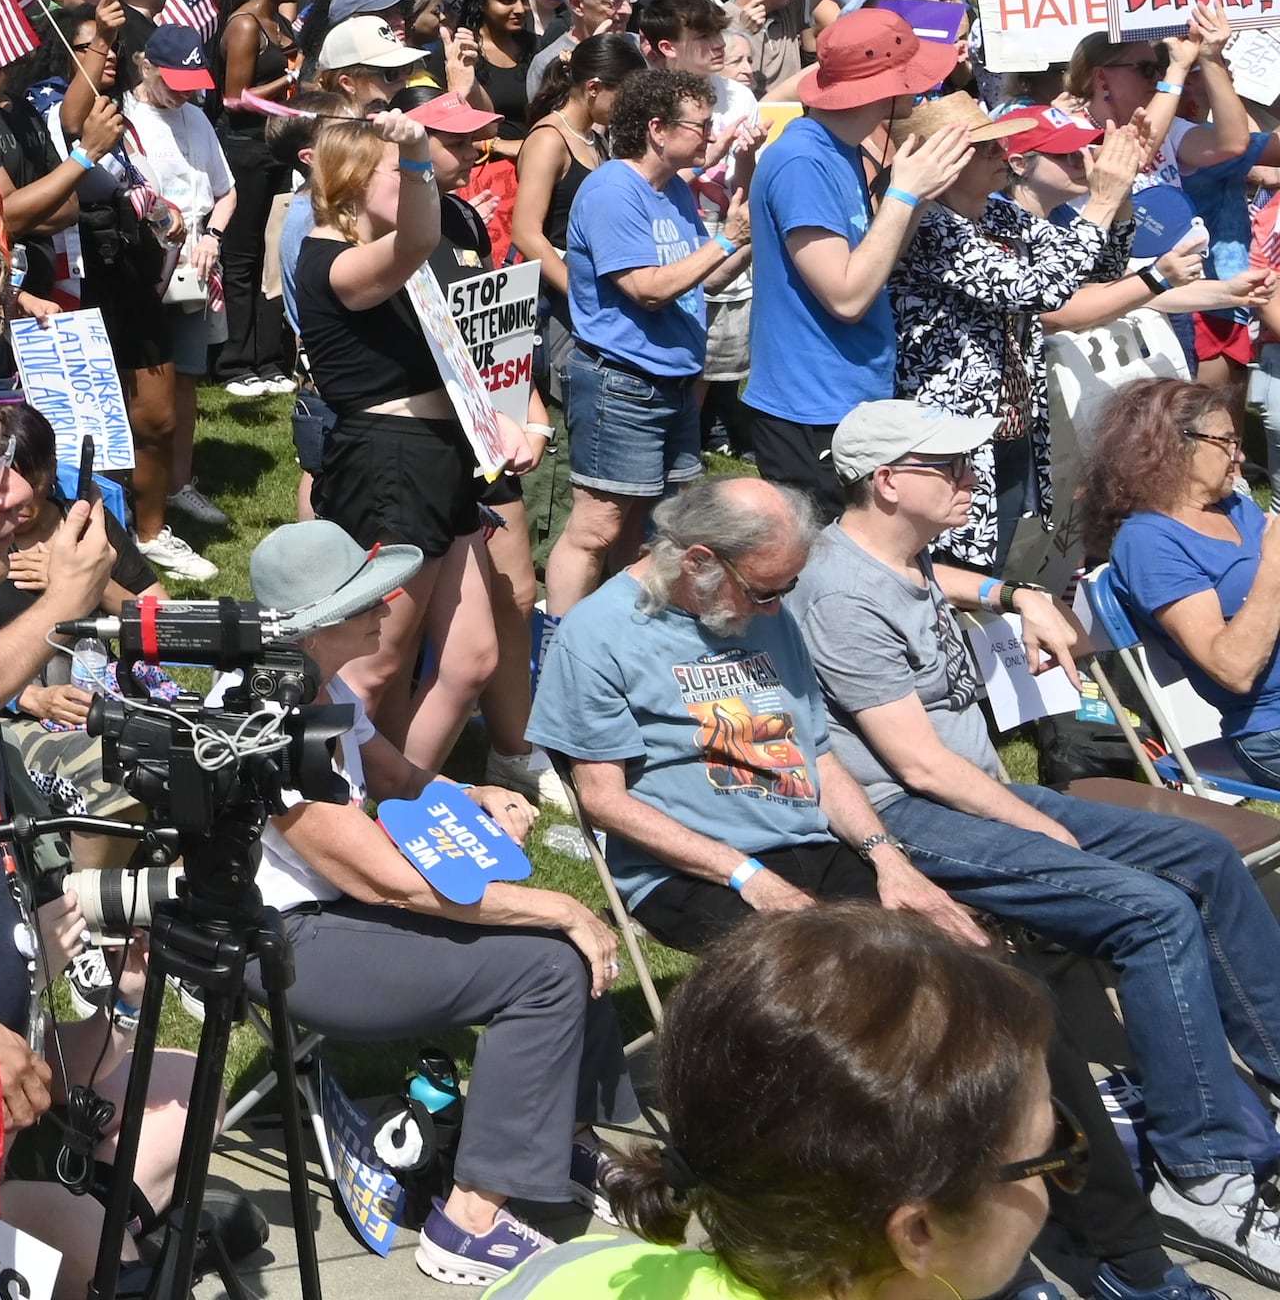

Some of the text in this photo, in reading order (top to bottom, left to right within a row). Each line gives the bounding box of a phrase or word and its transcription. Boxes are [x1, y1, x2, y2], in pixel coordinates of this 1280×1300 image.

[452, 272, 508, 318] STOP
[454, 297, 536, 347] PRETENDING
[11, 319, 66, 385] NATIVE
[991, 642, 1006, 653] ASL
[1004, 655, 1026, 667] ONLY
[672, 651, 778, 694] SUPERMAN
[682, 686, 743, 704] ULTIMATE
[745, 680, 783, 694] FLIGHT
[426, 801, 498, 870] PEOPLE
[427, 826, 465, 860] the
[474, 814, 503, 837] ACLU
[405, 835, 442, 872] WE
